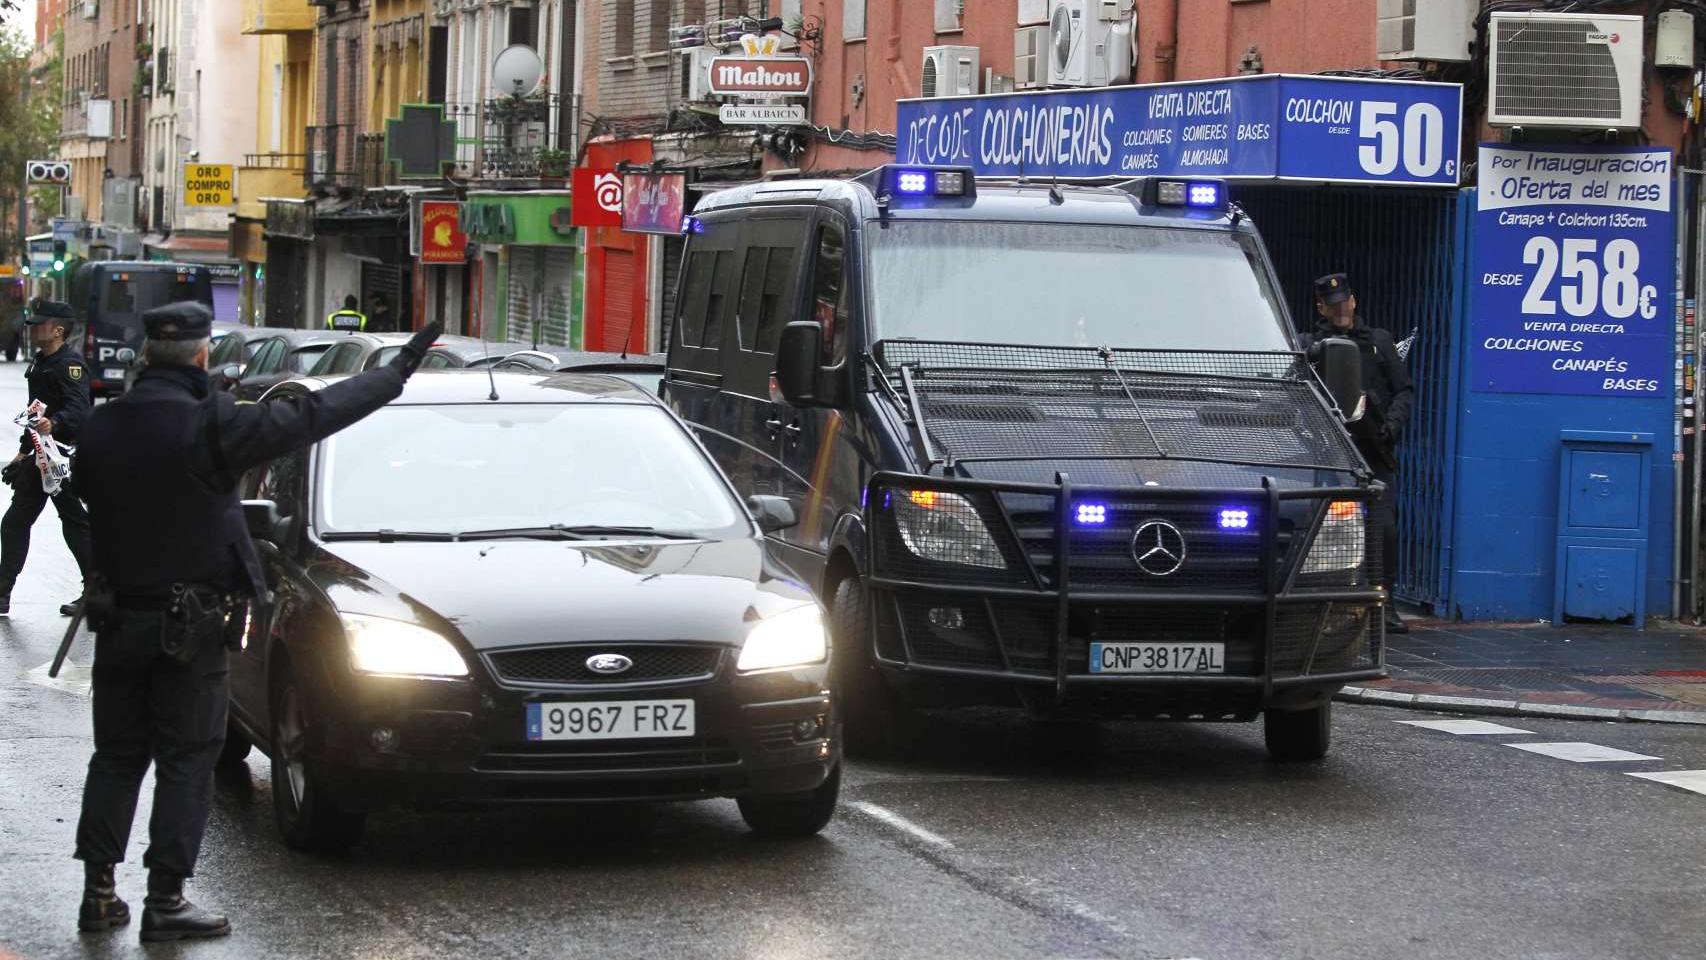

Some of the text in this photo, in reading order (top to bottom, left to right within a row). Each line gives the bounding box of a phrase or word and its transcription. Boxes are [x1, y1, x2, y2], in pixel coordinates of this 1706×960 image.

[718, 65, 802, 86] Mahou
[1149, 88, 1232, 119] VENTA DIRECTA
[1286, 98, 1353, 124] COLCHON
[726, 109, 799, 119] BAR ALBAICIN
[908, 103, 1114, 166] DECODE COLCHONERIAS
[1123, 123, 1271, 147] COLCHONES SOMIERES BASES
[1328, 126, 1352, 135] DESDE
[1122, 148, 1229, 170] CANAPÉS ALMOHADA
[1491, 153, 1667, 175] Por Inauguración
[196, 166, 221, 177] ORO
[186, 180, 231, 190] COMPRO
[1582, 180, 1609, 199] del
[1618, 183, 1660, 201] mes
[196, 193, 221, 203] ORO
[1499, 211, 1545, 228] Canape
[1558, 212, 1606, 227] Colchon
[1483, 273, 1523, 286] DESDE
[1524, 322, 1624, 334] VENTA DIRECTA
[1484, 337, 1584, 352] COLCHONES
[1552, 357, 1628, 373] CANAPÉS
[1603, 378, 1658, 391] BASES
[549, 704, 687, 734] 9967 FRZ
